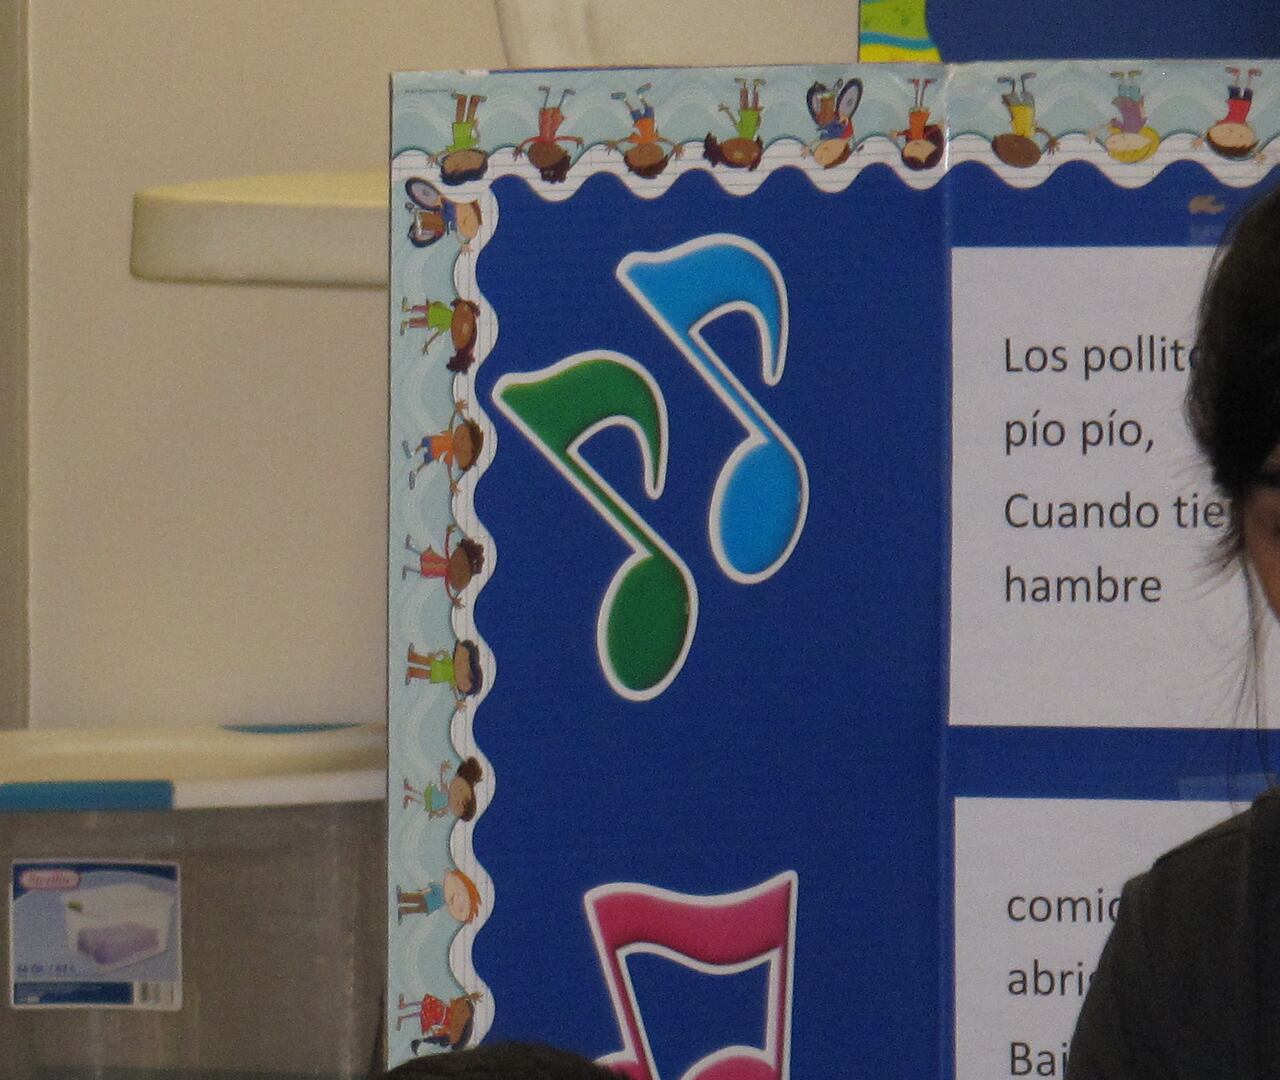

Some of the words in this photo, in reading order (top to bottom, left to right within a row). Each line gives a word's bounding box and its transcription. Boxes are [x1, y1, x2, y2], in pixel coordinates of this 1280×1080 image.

[1004, 337, 1068, 373] Los
[1004, 409, 1066, 456] pío
[1081, 409, 1155, 456] pío,
[1004, 491, 1160, 529] Cuando
[1004, 565, 1162, 603] hambre
[1007, 958, 1099, 997] abri
